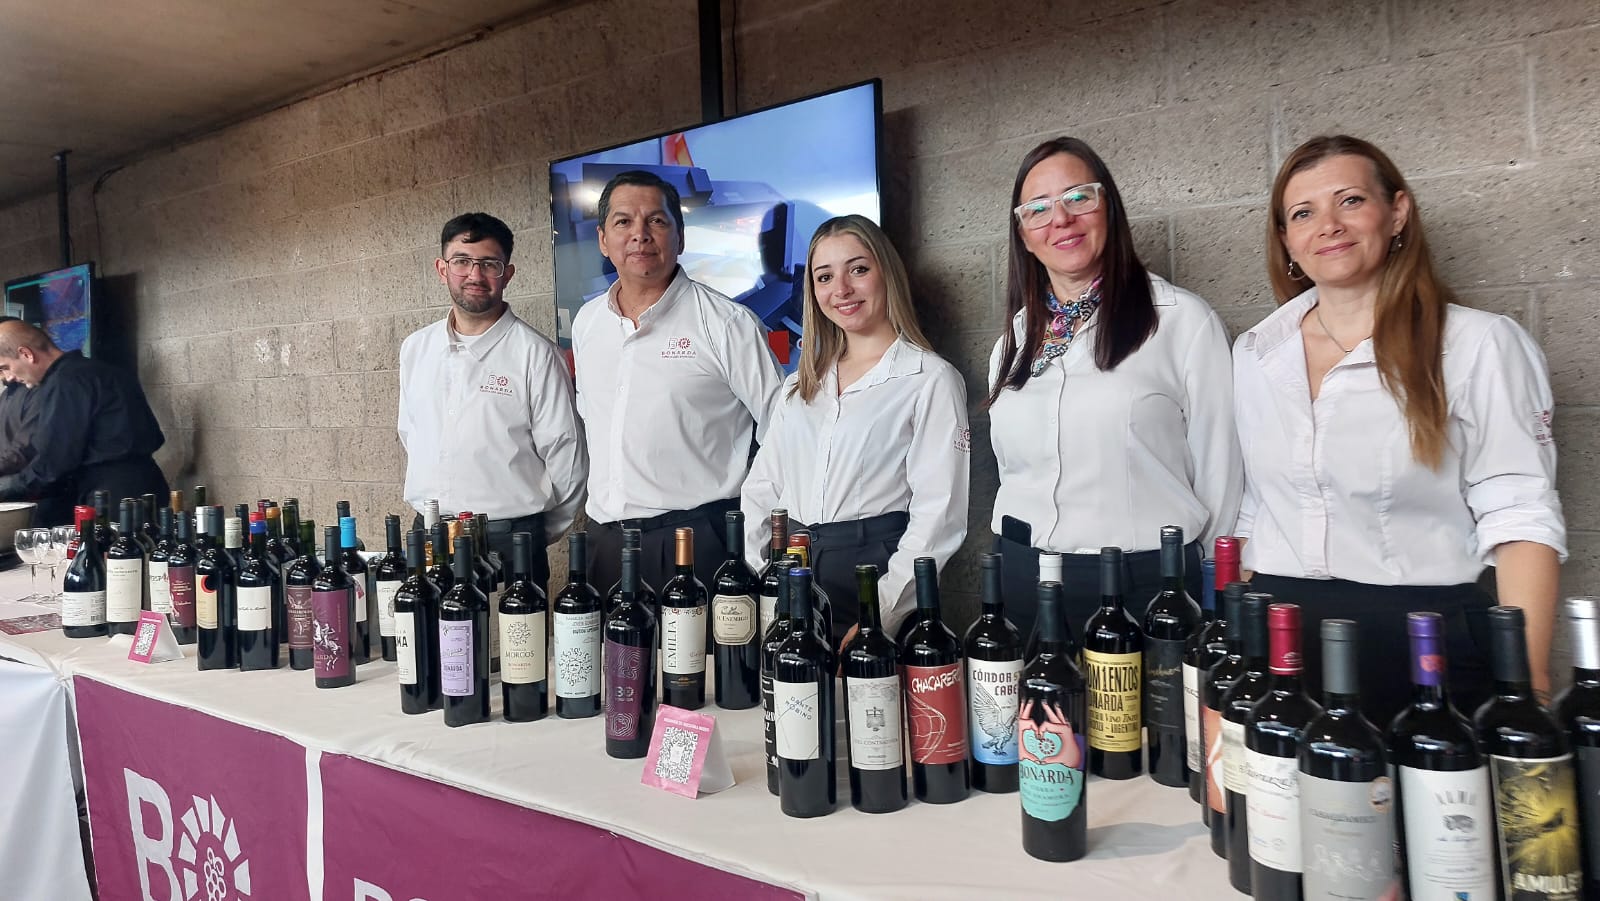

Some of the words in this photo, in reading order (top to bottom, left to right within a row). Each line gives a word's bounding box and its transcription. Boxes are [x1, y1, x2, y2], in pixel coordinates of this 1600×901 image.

[667, 619, 677, 669] EMILIA
[972, 669, 1012, 684] CÓNDOR
[784, 700, 813, 721] ROBINO
[790, 696, 814, 713] DANTE
[1019, 764, 1075, 786] BONARDA
